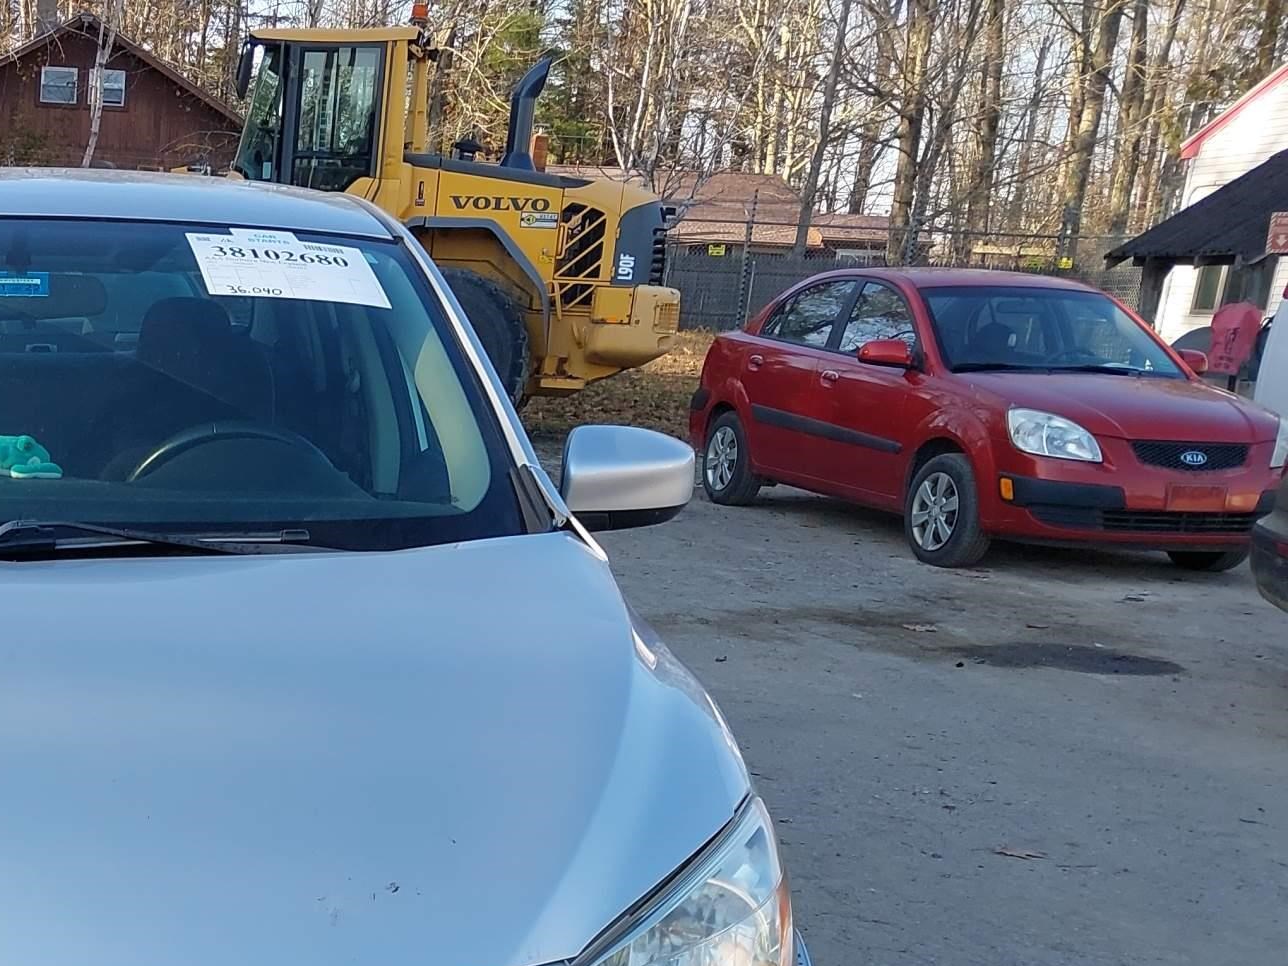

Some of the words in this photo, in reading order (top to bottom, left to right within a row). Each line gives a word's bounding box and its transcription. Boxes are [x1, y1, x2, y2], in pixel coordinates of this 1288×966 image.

[449, 195, 550, 212] VOLVO
[211, 245, 349, 268] 38102680
[616, 253, 636, 281] L90F
